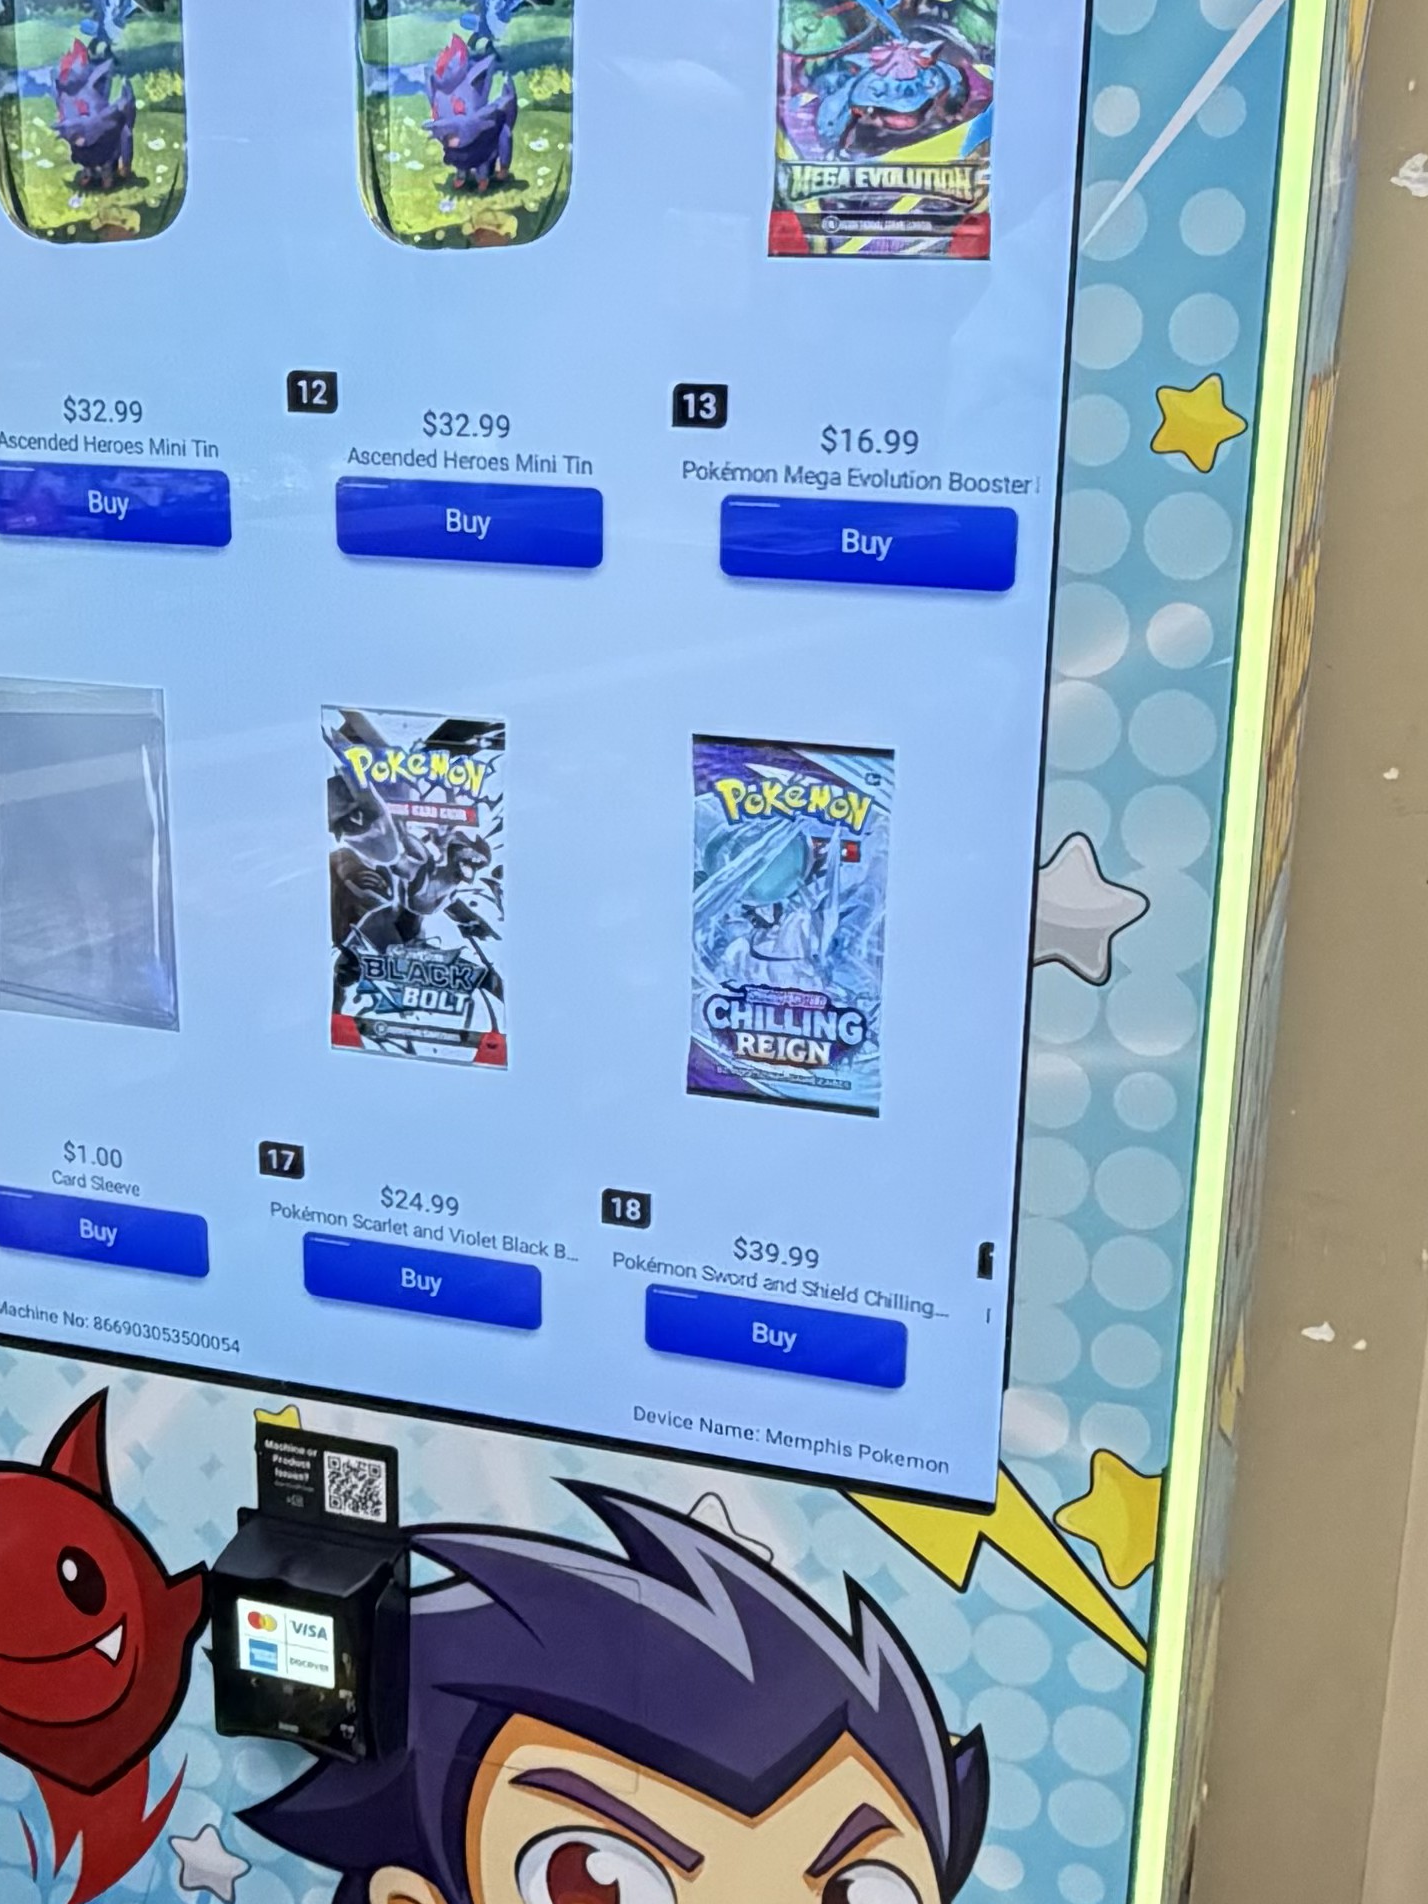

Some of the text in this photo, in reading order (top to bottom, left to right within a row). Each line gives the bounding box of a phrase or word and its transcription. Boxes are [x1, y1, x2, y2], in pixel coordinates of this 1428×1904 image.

[296, 379, 328, 405] 12
[683, 392, 717, 419] 13
[62, 397, 143, 425] $32.99
[422, 411, 510, 439] $32.99
[83, 437, 144, 455] Heroes
[149, 438, 186, 456] Mini
[191, 440, 219, 459] Tin
[820, 425, 919, 456] $16.99
[347, 447, 593, 476] Ascended Heroes Mini Tin
[682, 459, 1031, 494] Pokémon Mega Evolution Booster
[88, 491, 130, 520] Buy
[446, 509, 491, 540] Buy
[842, 528, 893, 561] Buy
[706, 998, 864, 1043] CHILLING
[736, 1033, 830, 1065] REIGN
[63, 1141, 123, 1170] $1.00
[266, 1149, 296, 1172] 17
[52, 1170, 141, 1197] Card Sleeve
[379, 1185, 459, 1217] $24.99
[611, 1198, 641, 1221] 18
[79, 1218, 119, 1248] Buy
[270, 1202, 550, 1259] Pokémon Scarlet and Violet Black
[733, 1236, 820, 1269] $39.99
[401, 1268, 443, 1298] Buy
[612, 1251, 859, 1304] Pokémon Sword and Shield
[93, 1315, 241, 1354] 866903053500054
[752, 1321, 797, 1353] Buy
[633, 1405, 950, 1475] Device Name: Memphis Pokemon
[290, 1619, 328, 1641] VISA
